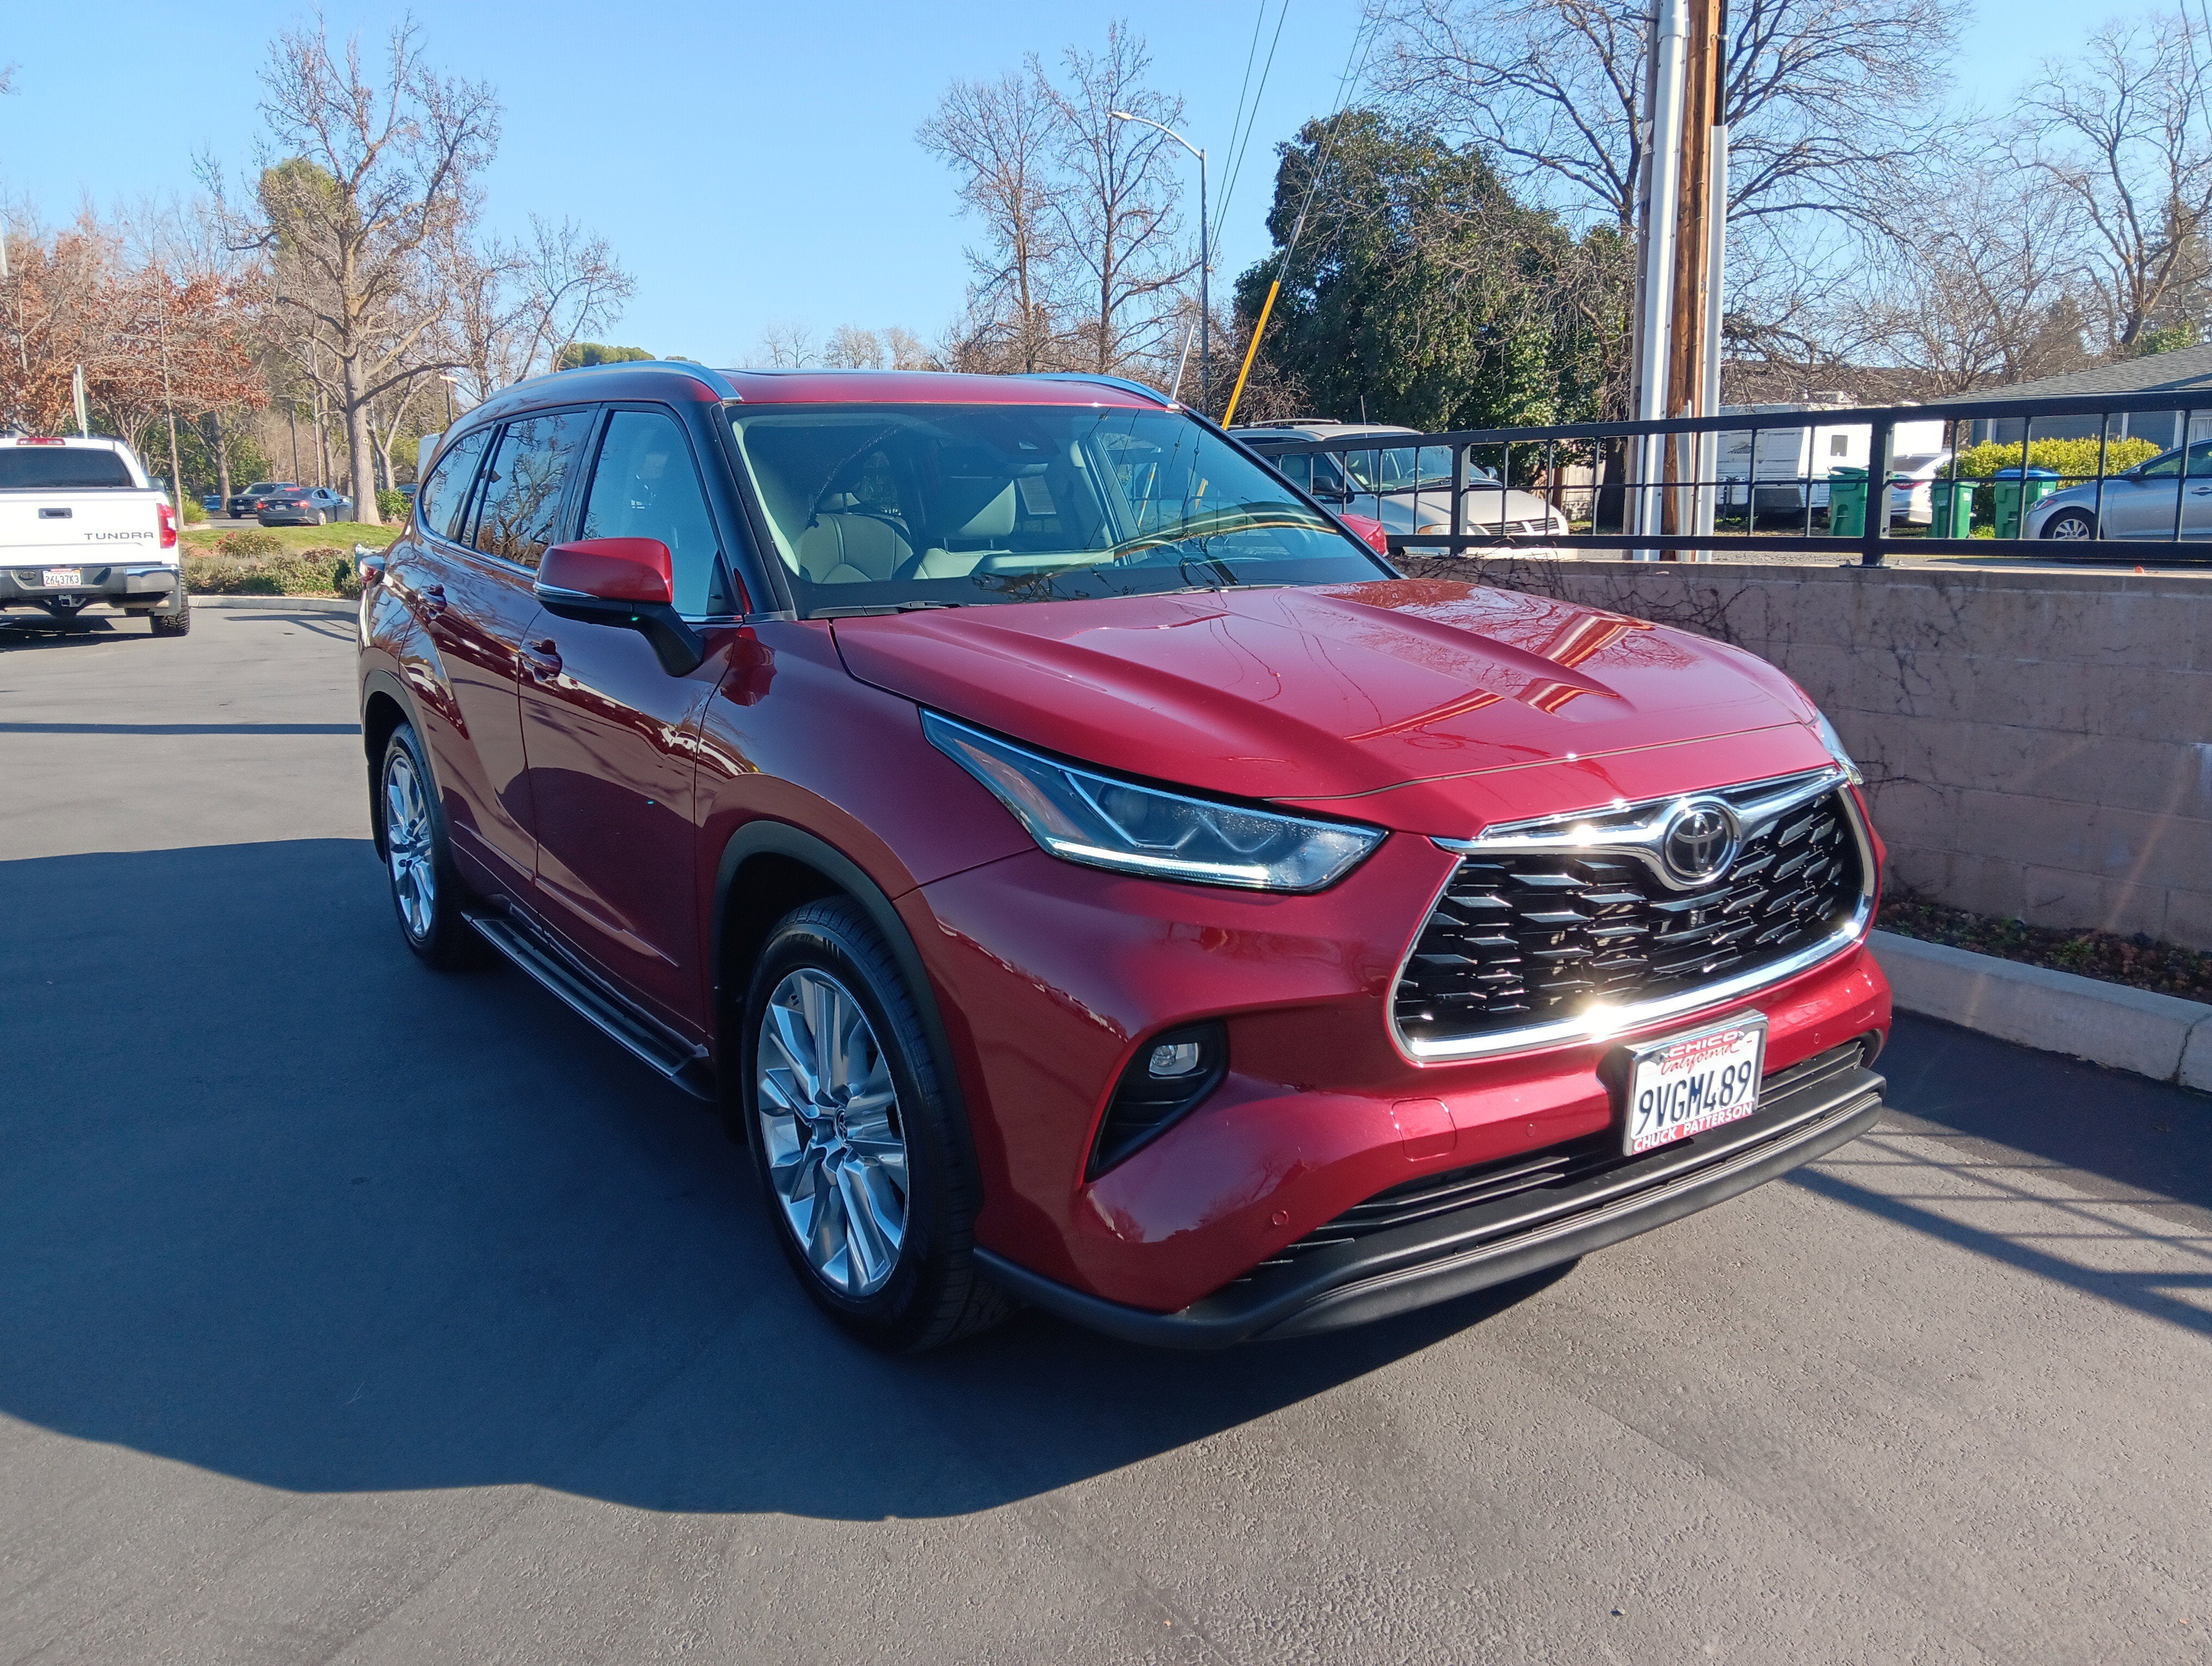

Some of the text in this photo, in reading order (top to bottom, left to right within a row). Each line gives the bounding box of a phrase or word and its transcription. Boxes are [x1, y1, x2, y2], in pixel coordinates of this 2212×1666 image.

[84, 531, 153, 540] TUNDRA
[45, 575, 79, 585] 26437K3
[1668, 1031, 1738, 1058] CHICO
[1661, 1045, 1740, 1075] California
[1636, 1060, 1752, 1136] 9VGM489
[1634, 1102, 1753, 1152] CHUCK PATTERSON
